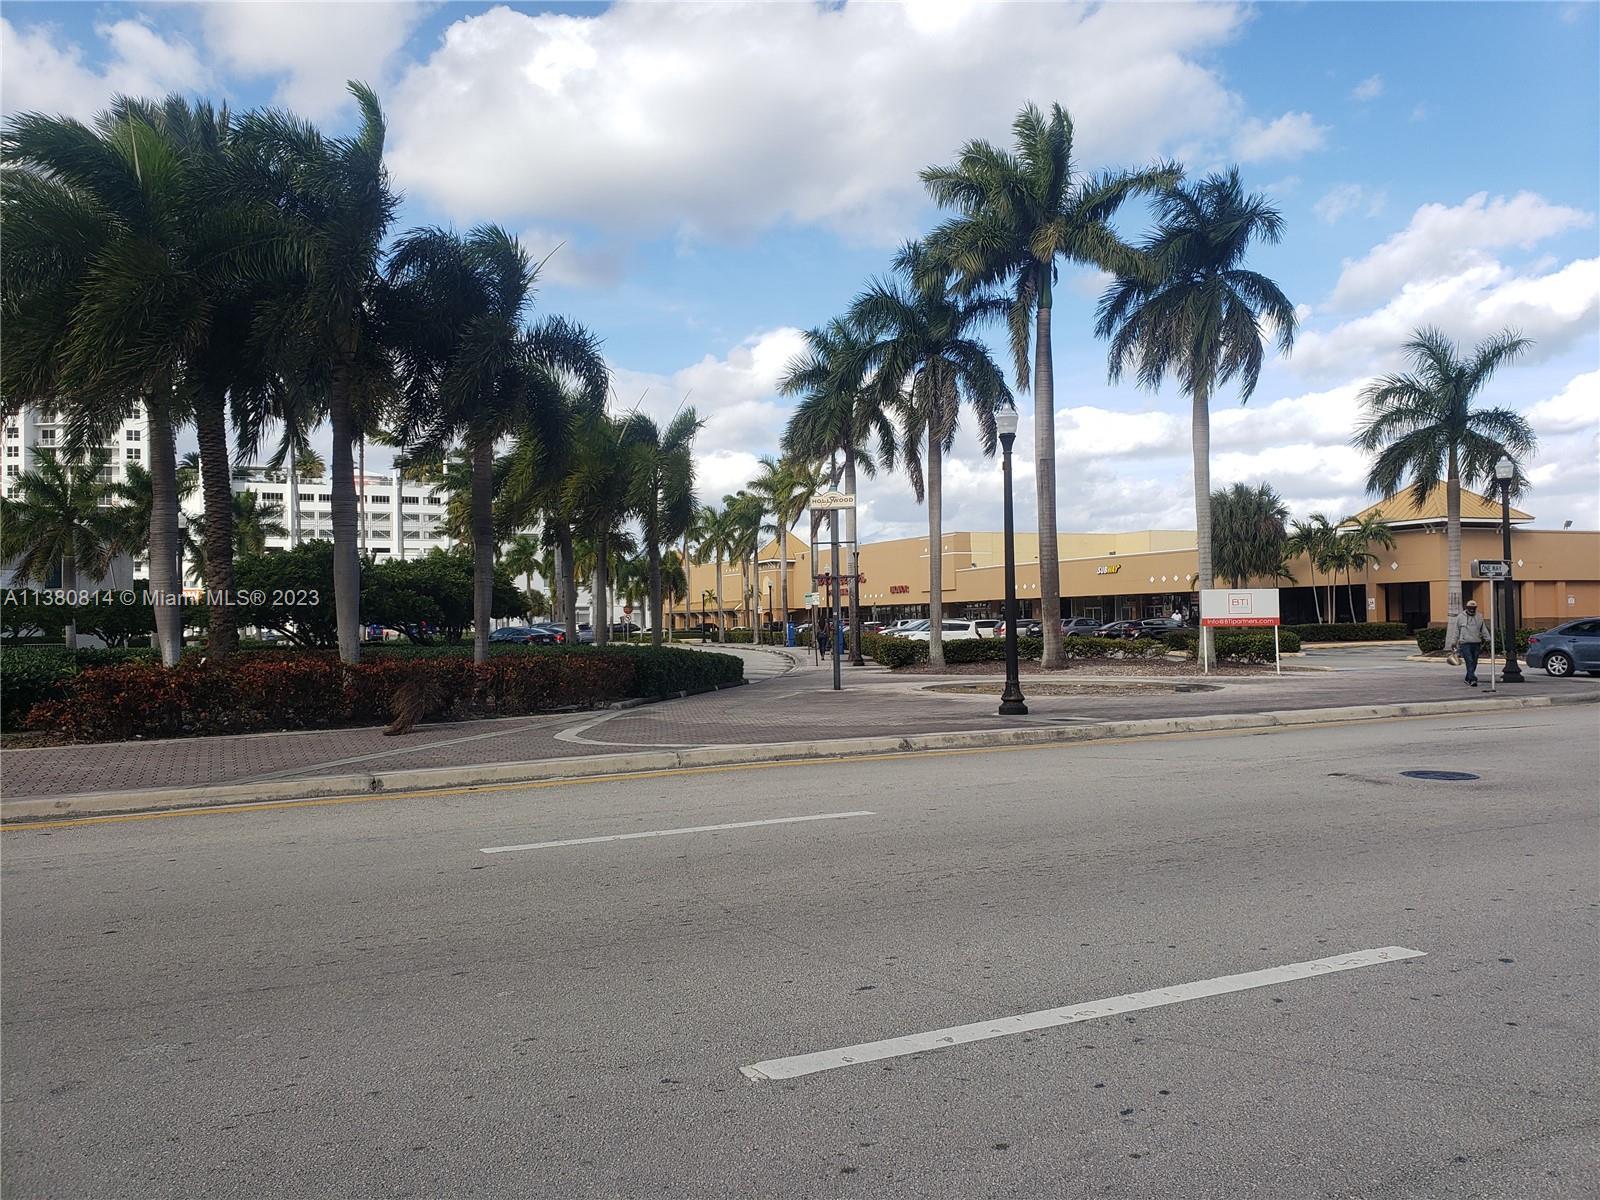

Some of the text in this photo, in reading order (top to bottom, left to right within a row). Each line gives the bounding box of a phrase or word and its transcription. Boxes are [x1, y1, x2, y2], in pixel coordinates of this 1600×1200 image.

[811, 496, 854, 506] HOLLYWOOD
[1097, 564, 1121, 575] SUBWAY
[1482, 564, 1491, 572] ONE
[1231, 598, 1249, 606] BTI
